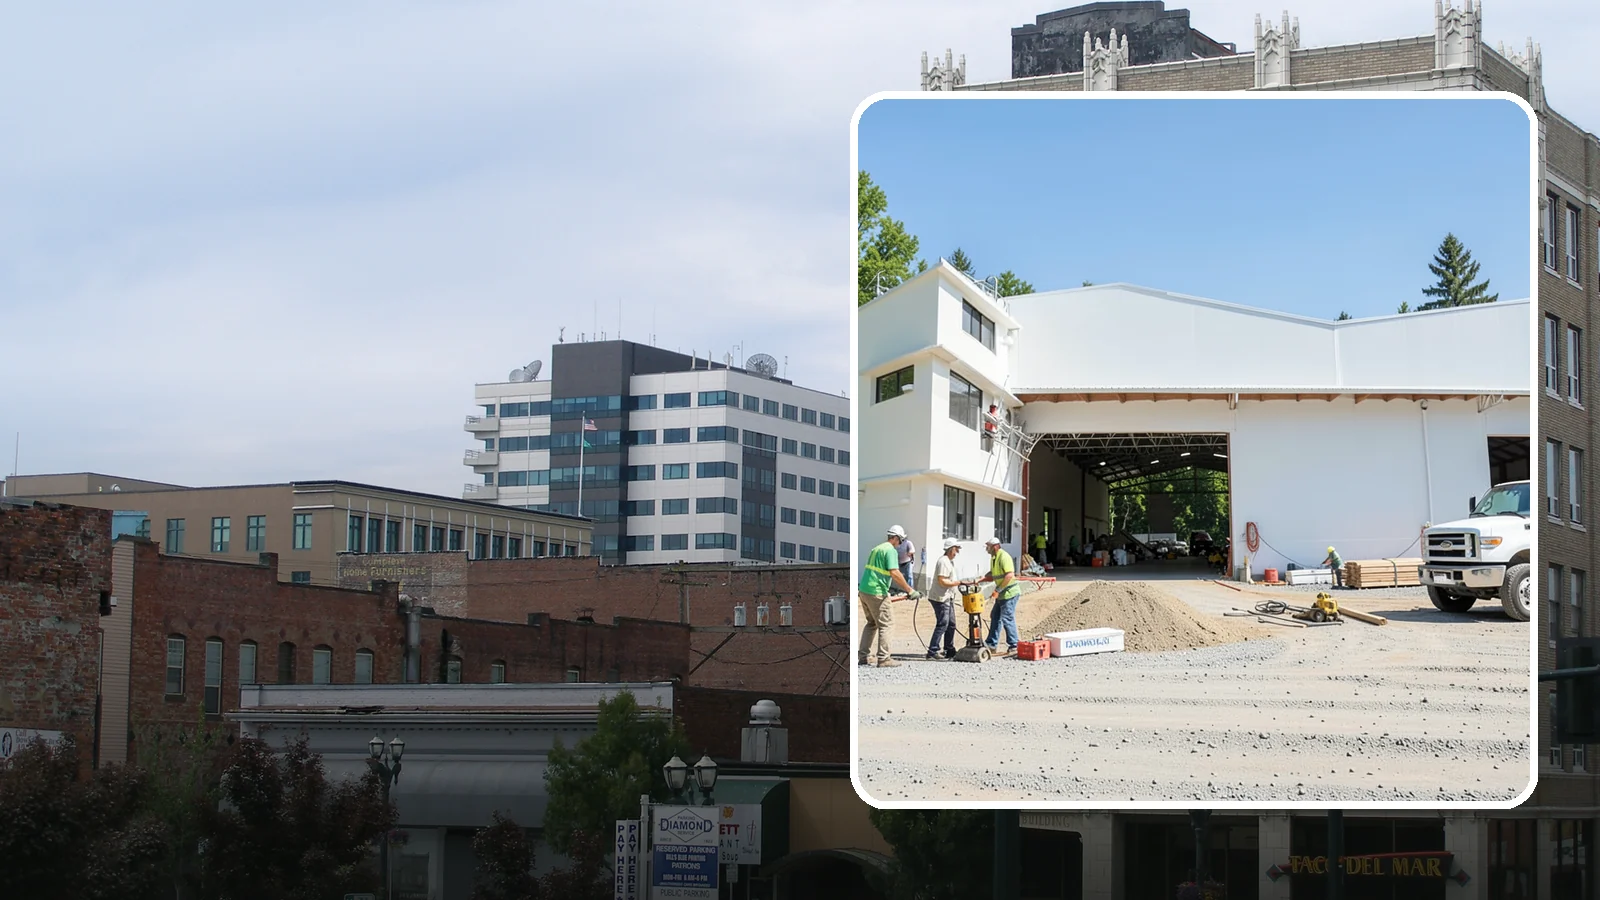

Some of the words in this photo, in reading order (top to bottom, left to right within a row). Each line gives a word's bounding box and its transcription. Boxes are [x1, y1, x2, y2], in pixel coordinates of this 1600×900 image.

[343, 568, 368, 577] Home
[370, 566, 427, 577] Furnishers
[660, 818, 713, 833] DIAMOND
[1022, 815, 1070, 828] BUILDING
[655, 845, 688, 853] RESERVED
[689, 846, 716, 854] PARKING
[721, 851, 739, 862] Soup
[671, 862, 701, 870] PATRONS
[1346, 856, 1385, 876] DEL
[1392, 857, 1442, 877] MAR
[660, 888, 682, 897] PUBLIC
[683, 889, 710, 898] PARKING
